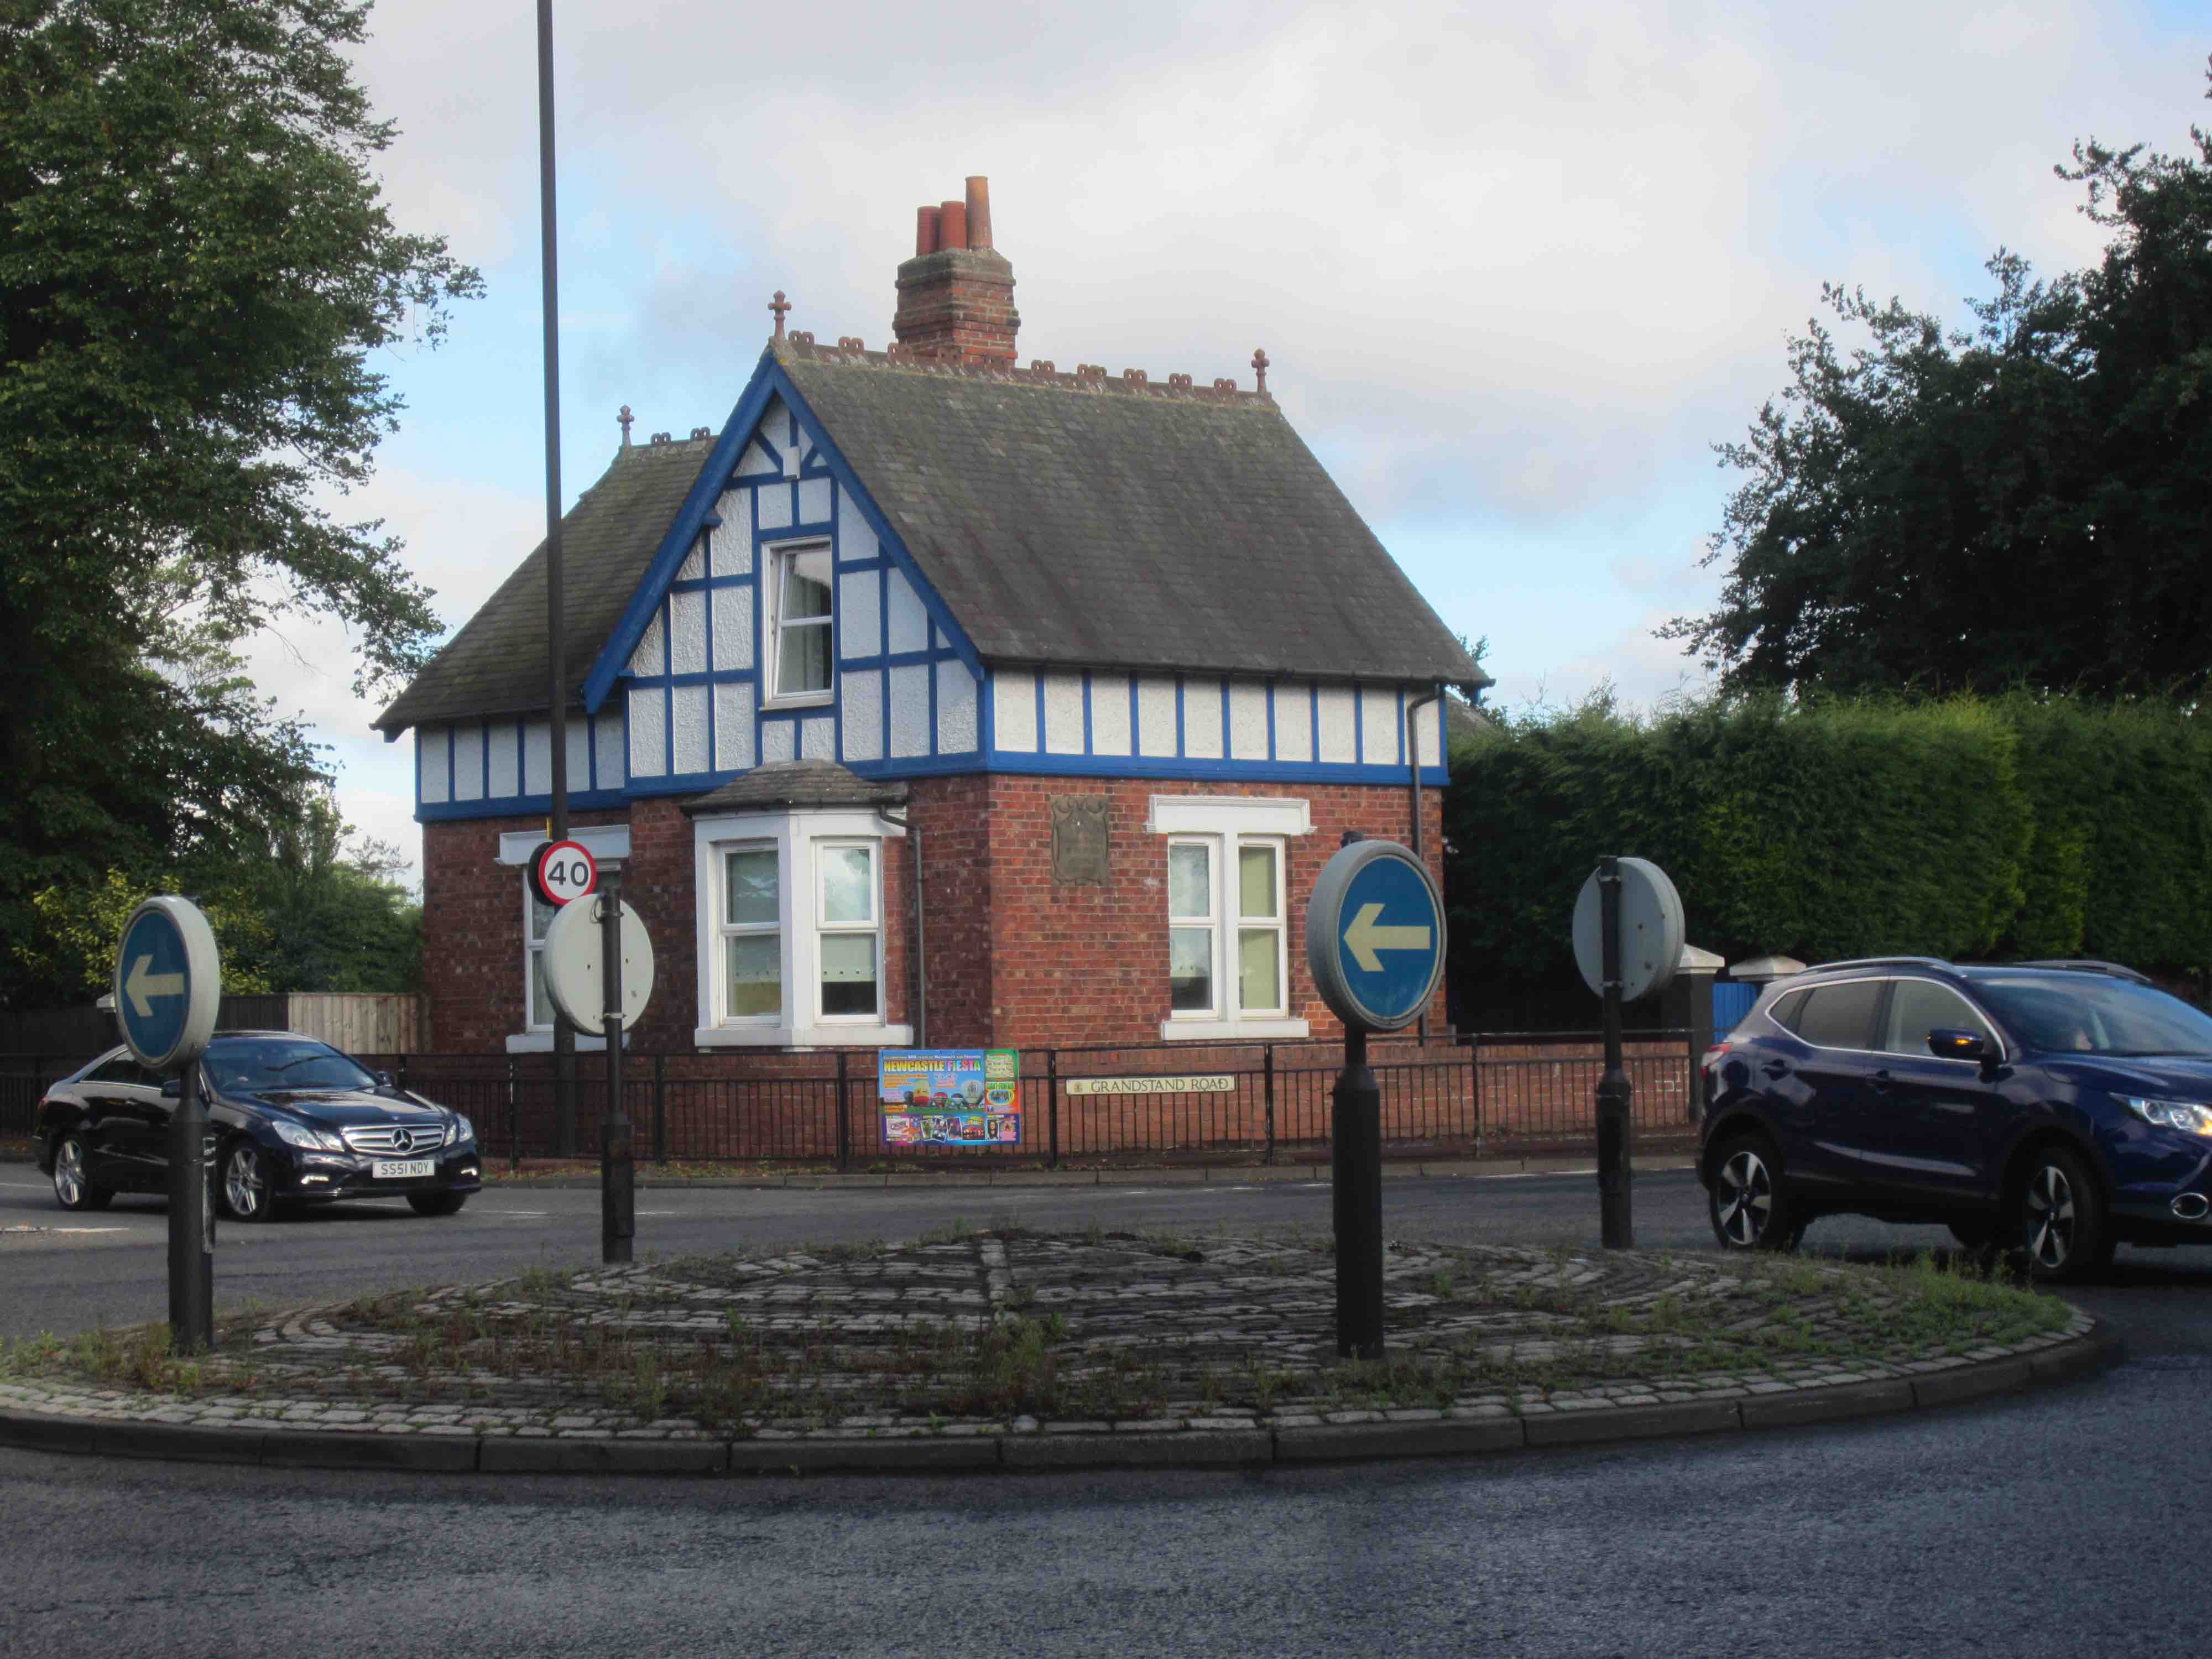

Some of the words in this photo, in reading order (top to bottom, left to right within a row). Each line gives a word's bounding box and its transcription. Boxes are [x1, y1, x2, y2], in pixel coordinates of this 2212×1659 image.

[547, 860, 589, 886] 40
[884, 1061, 945, 1071] NEWCASTLE
[1091, 1079, 1185, 1092] GRANDSTAND
[1191, 1078, 1228, 1090] ROAD
[410, 1163, 429, 1173] NDY
